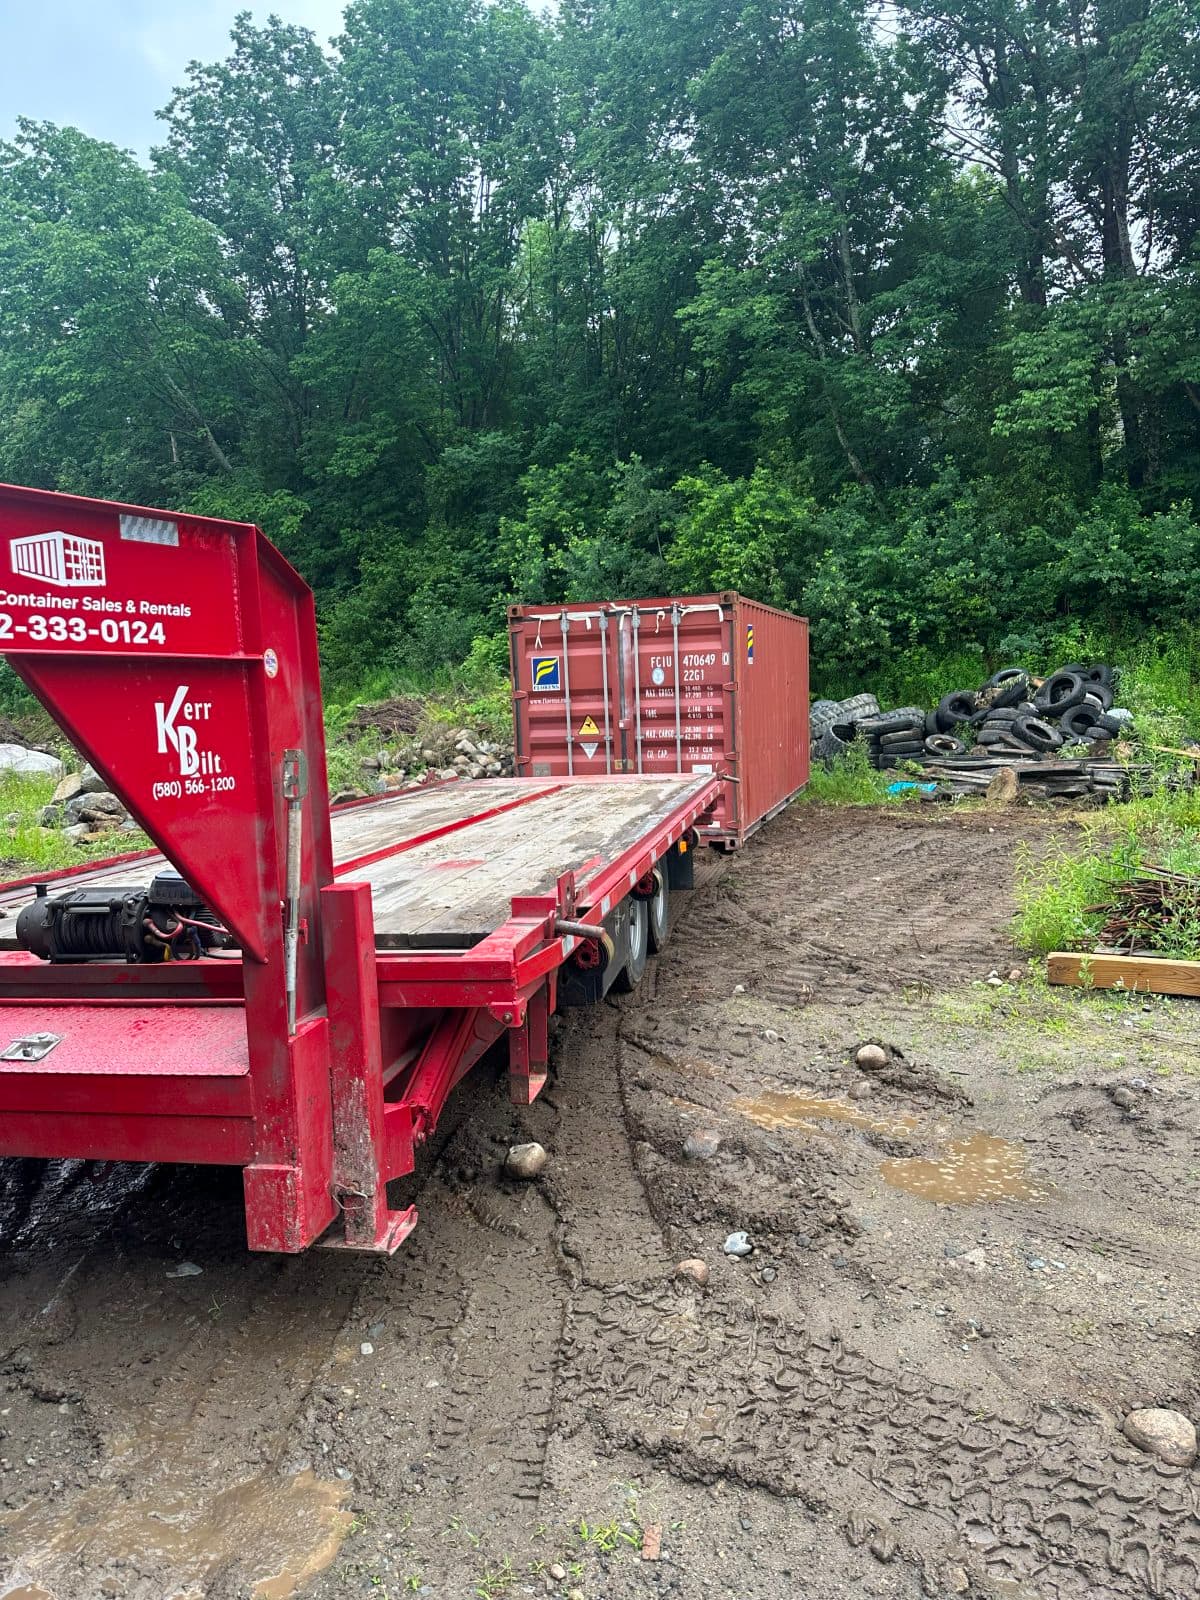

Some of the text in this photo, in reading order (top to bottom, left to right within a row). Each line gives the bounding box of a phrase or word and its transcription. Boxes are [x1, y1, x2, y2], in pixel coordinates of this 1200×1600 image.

[82, 596, 122, 613] Sales
[125, 600, 136, 613] &
[140, 601, 192, 617] Rentals
[650, 656, 673, 668] FCIU
[682, 653, 716, 667] 470649
[683, 669, 705, 681] 22G1
[154, 685, 212, 753] Kerr
[177, 725, 222, 777] Bilt
[153, 776, 236, 801] (580) 566-1200
